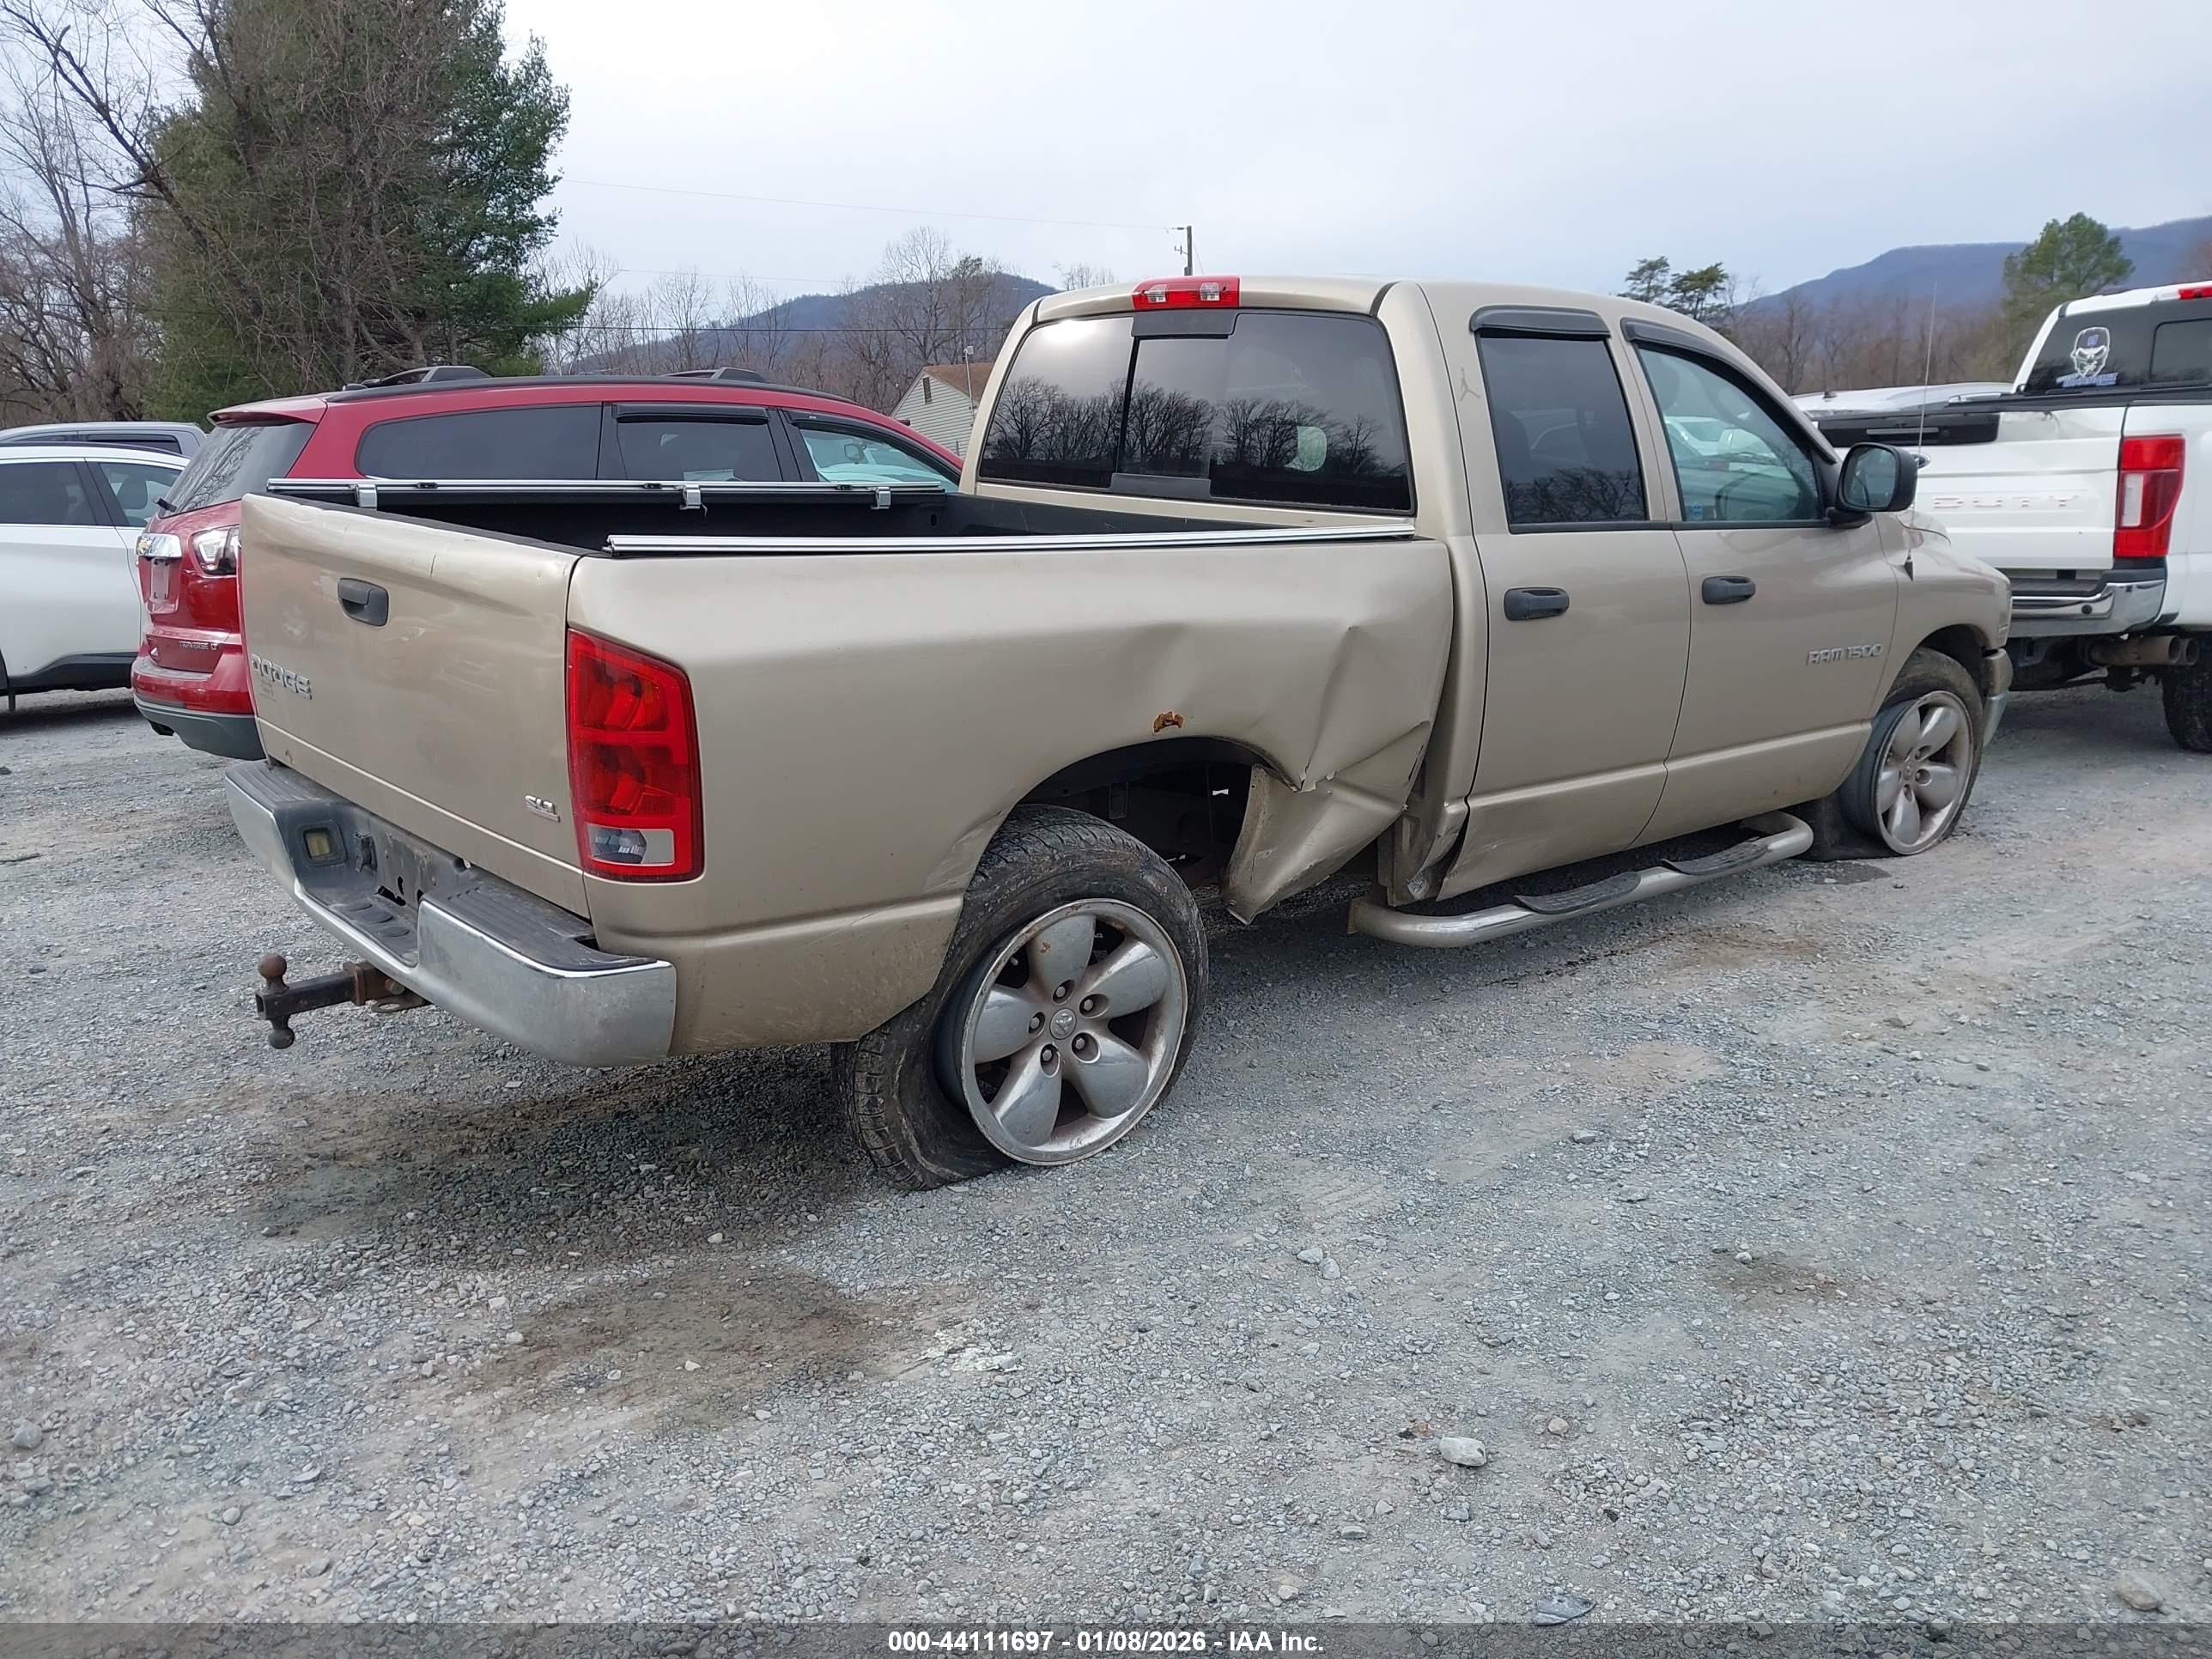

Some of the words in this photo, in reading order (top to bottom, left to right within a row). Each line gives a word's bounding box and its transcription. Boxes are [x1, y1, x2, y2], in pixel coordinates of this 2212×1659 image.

[1934, 495, 2079, 509] DUTY
[179, 641, 209, 651] TRAVERSE
[1807, 647, 1843, 665] RAM
[1846, 643, 1883, 659] 1500
[251, 653, 313, 699] DODGE
[525, 795, 558, 817] SLT
